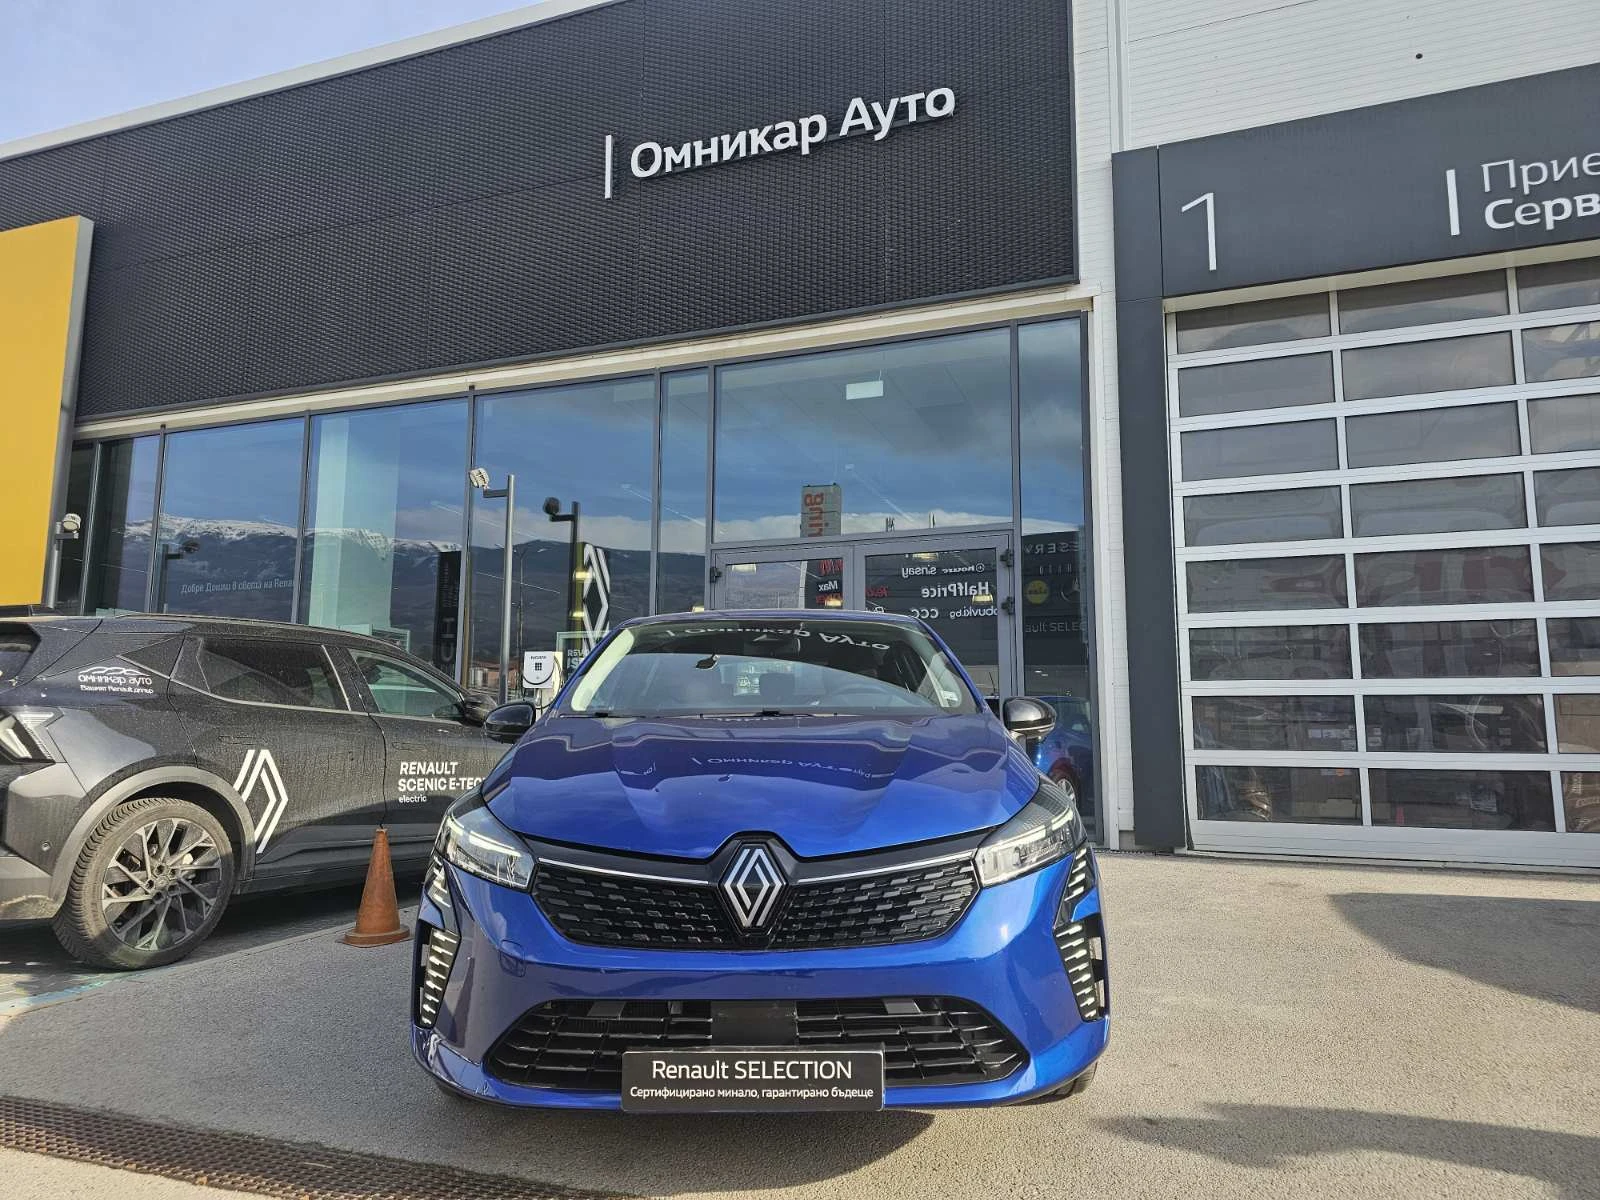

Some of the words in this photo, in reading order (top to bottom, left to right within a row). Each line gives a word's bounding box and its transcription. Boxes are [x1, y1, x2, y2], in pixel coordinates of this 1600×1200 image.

[630, 113, 827, 178] Омникар
[839, 87, 956, 141] Ауто
[1181, 192, 1217, 270] 1
[399, 761, 459, 775] RENAULT
[398, 777, 447, 792] SCENIC
[449, 776, 485, 791] E-TEC
[398, 794, 428, 803] electric
[652, 1060, 729, 1080] Renault
[734, 1060, 852, 1080] SELECTION
[630, 1086, 715, 1099] Сертифицирано
[718, 1088, 759, 1099] минало,
[762, 1088, 829, 1099] гарантирано
[831, 1086, 874, 1099] бъдеще
